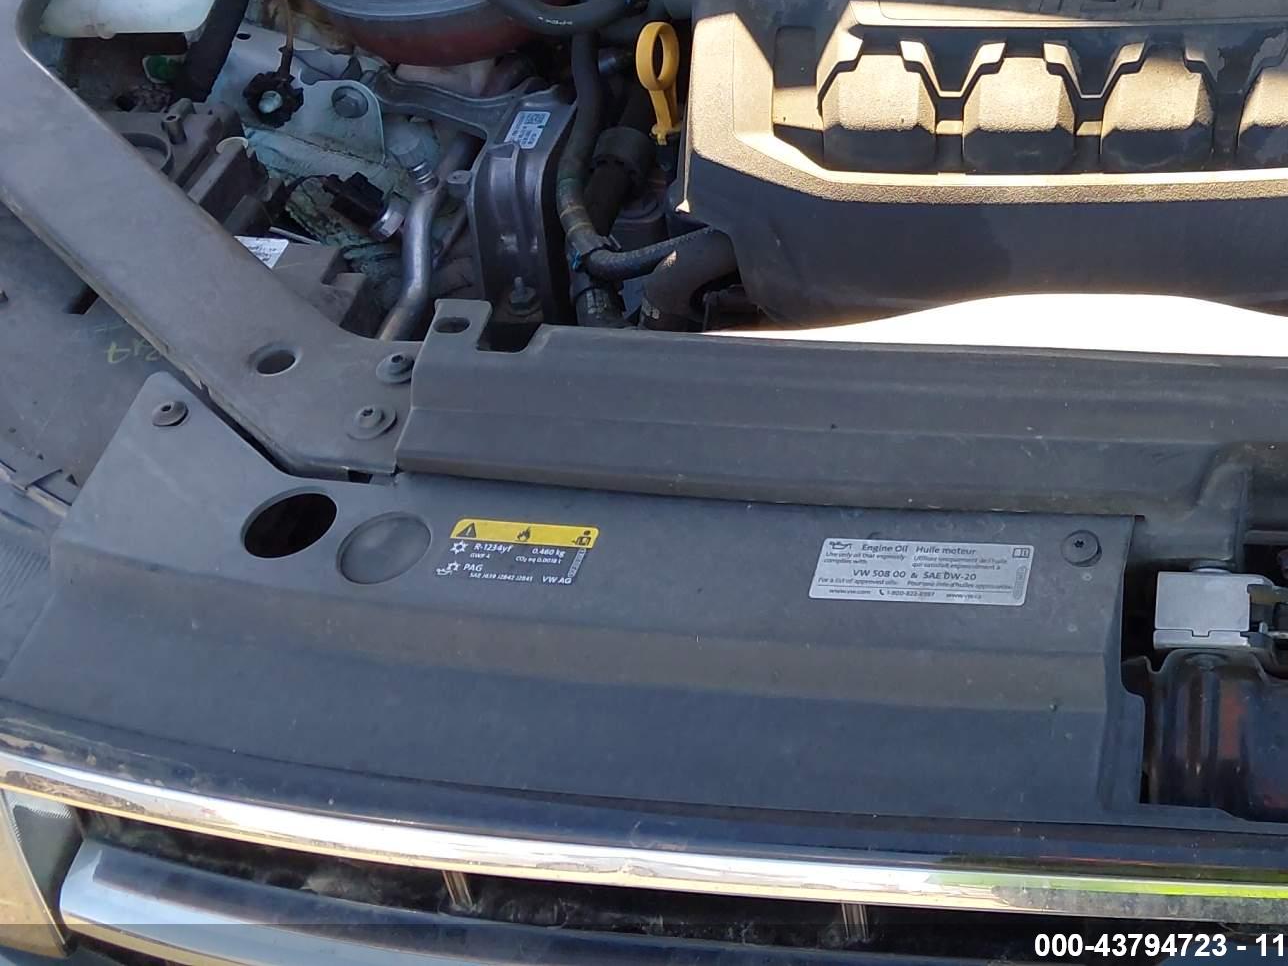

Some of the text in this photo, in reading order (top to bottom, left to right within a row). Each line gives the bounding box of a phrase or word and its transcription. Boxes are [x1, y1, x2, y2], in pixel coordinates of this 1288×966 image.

[474, 542, 514, 554] R-1234yf
[862, 544, 893, 553] Engine
[916, 546, 940, 554] Huile
[555, 548, 566, 558] kg
[463, 564, 484, 572] PAG
